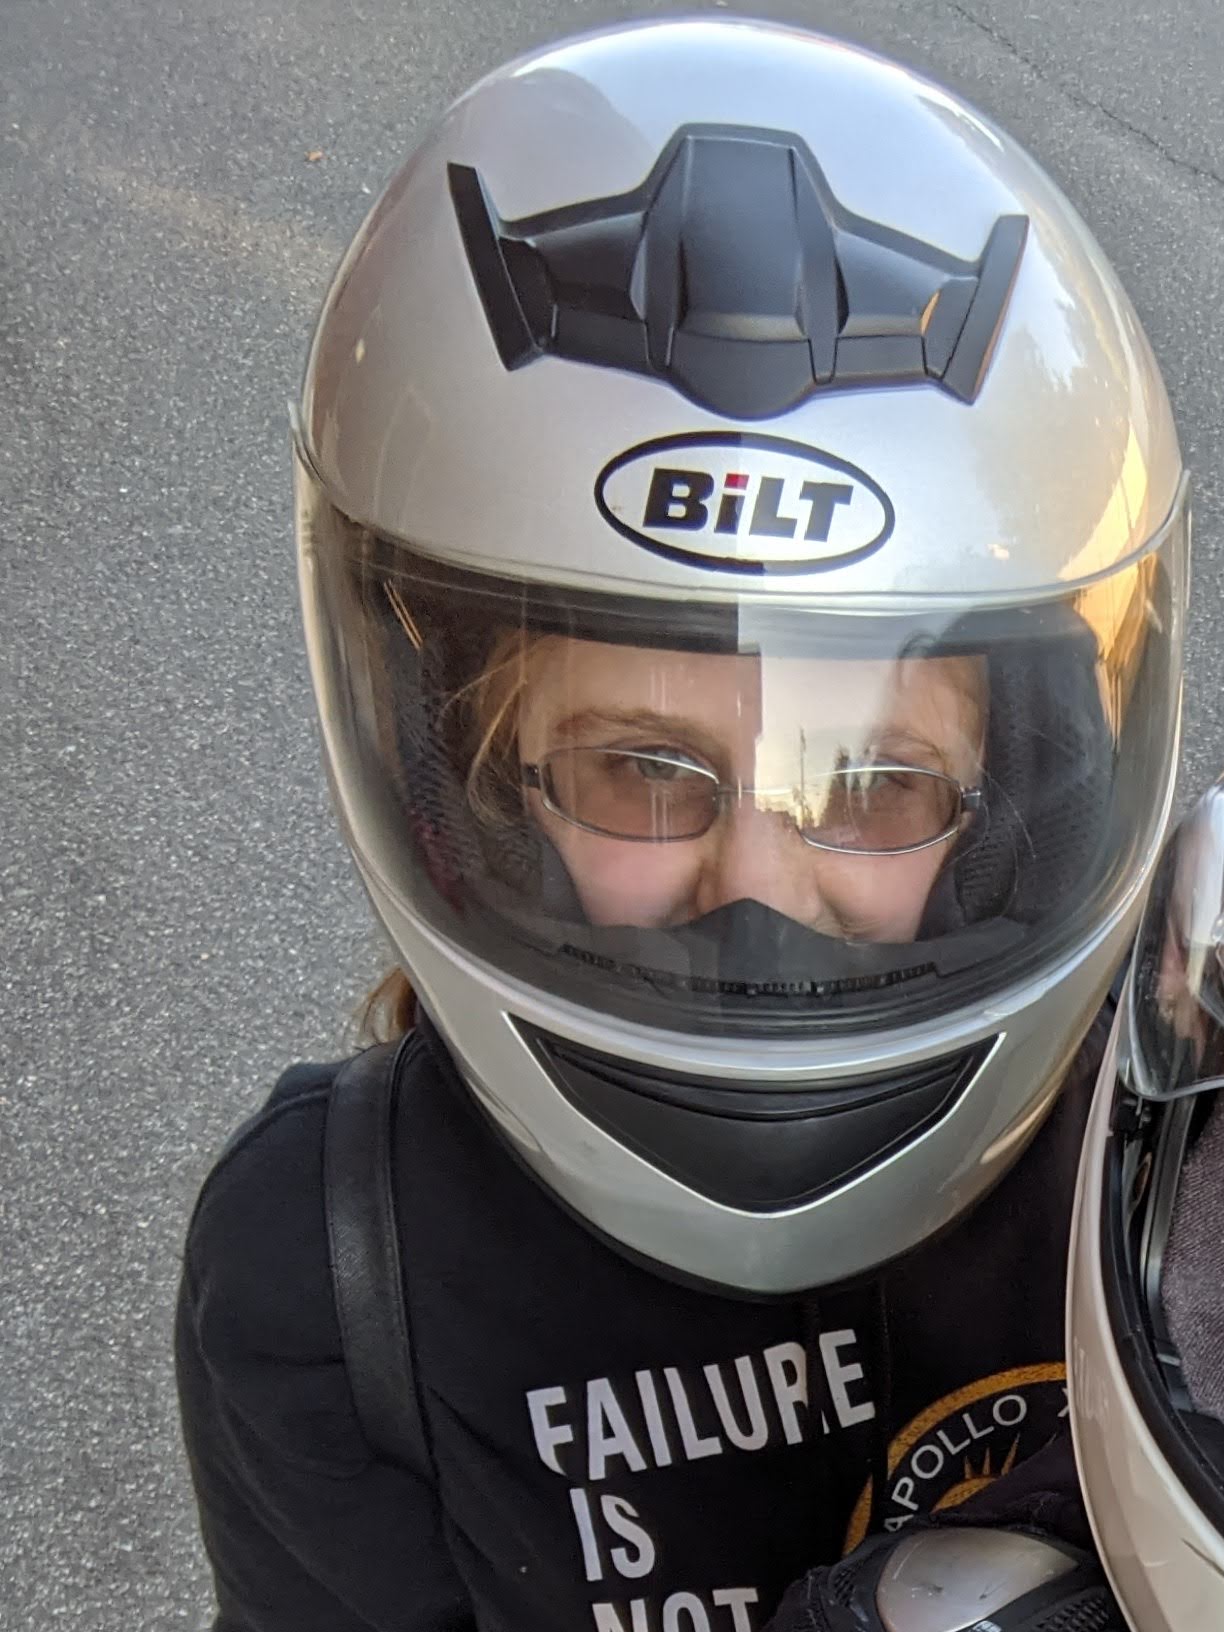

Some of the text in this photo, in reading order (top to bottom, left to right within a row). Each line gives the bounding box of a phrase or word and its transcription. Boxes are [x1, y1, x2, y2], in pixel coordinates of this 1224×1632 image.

[526, 1329, 876, 1481] FAILURE
[884, 1394, 1027, 1533] APOLLO
[568, 1487, 657, 1582] IS
